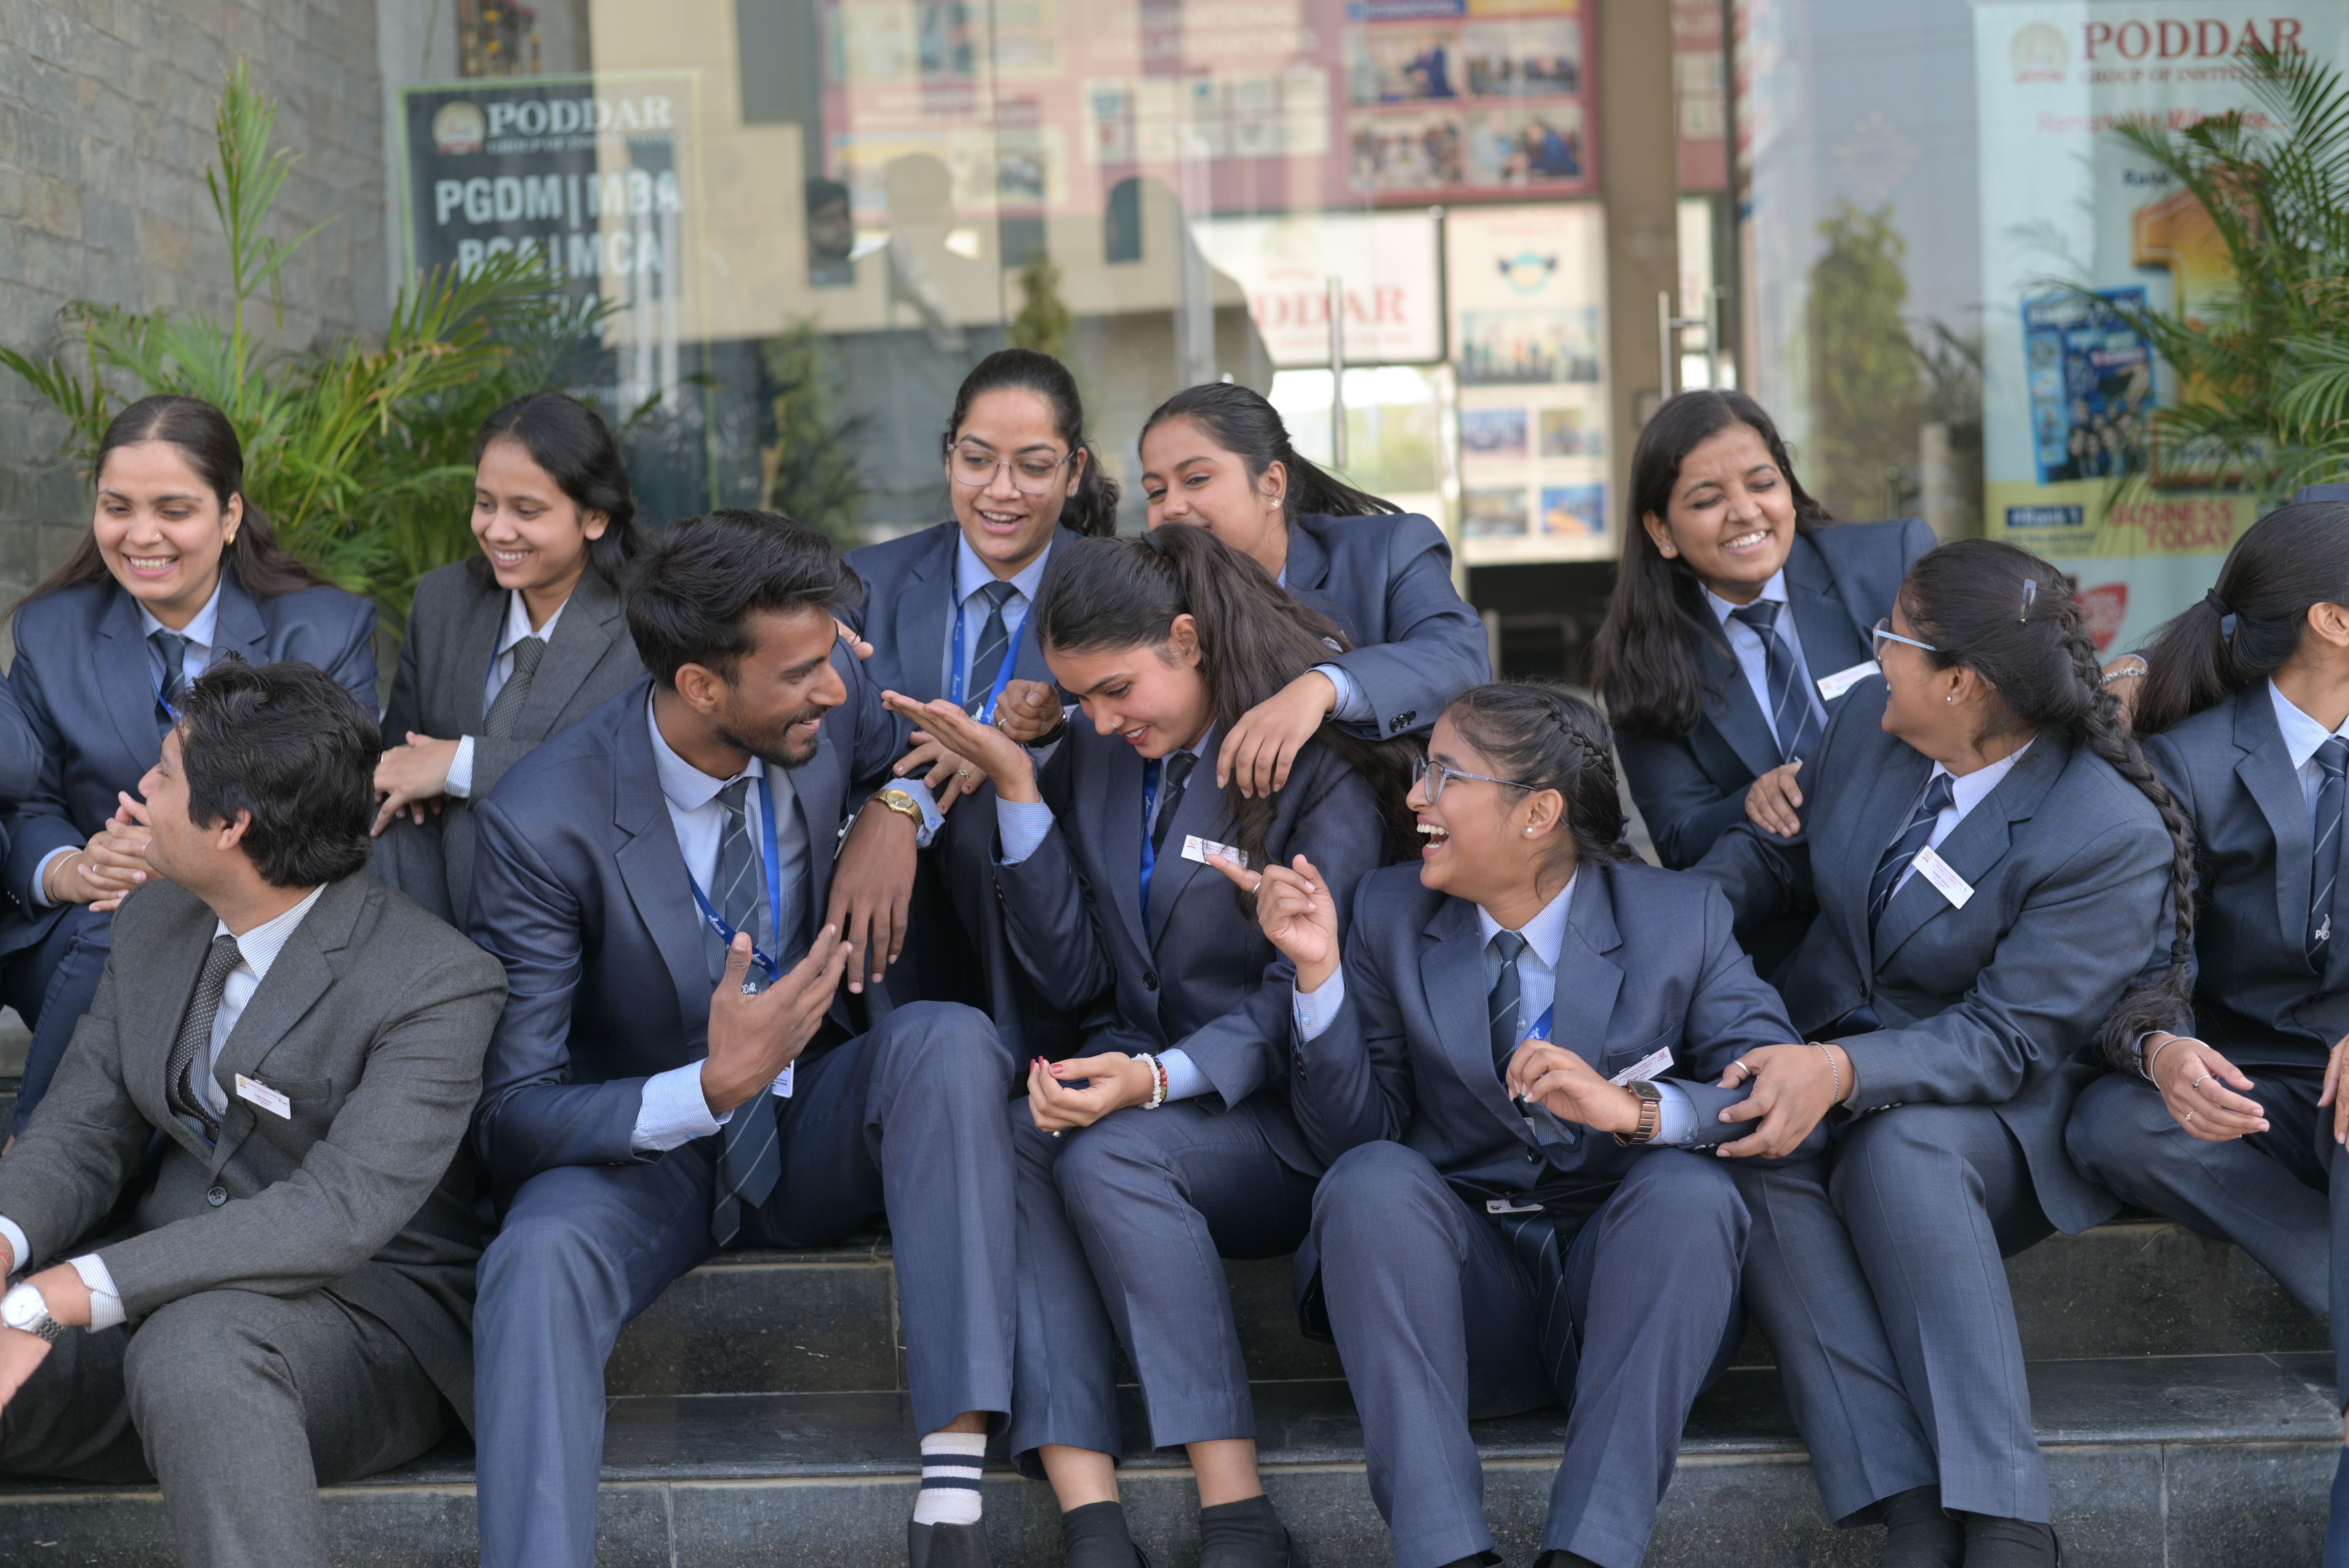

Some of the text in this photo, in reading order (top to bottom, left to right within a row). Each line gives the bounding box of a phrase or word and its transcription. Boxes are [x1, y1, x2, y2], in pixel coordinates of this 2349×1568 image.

[2081, 18, 2307, 61] PODDAR
[486, 95, 674, 137] PODDAR
[2146, 524, 2235, 550] TODAY
[708, 914, 725, 935] PODDAR
